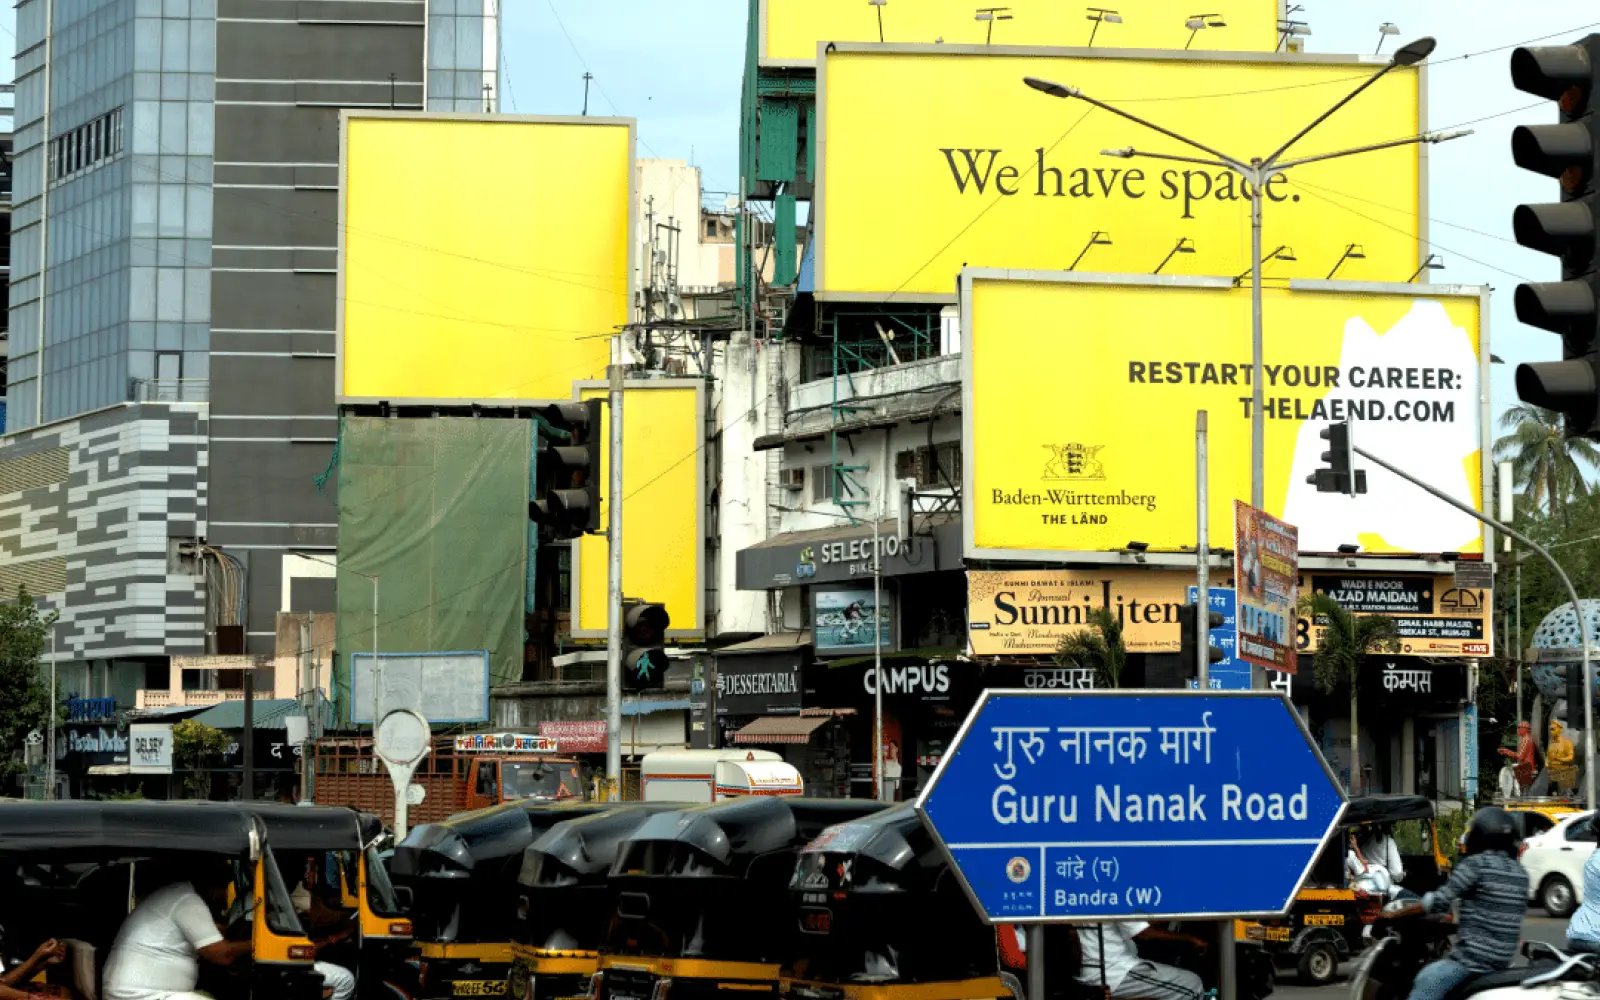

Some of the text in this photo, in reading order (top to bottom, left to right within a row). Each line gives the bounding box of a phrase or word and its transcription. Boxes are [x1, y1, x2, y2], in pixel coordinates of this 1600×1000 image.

[939, 147, 1301, 219] We have space.
[1128, 362, 1463, 390] RESTART YOUR CAREER:
[1239, 397, 1456, 423] THELAEND.COM
[991, 488, 1157, 512] Baden-Württemberg
[1041, 512, 1108, 525] THE LÄND
[850, 563, 882, 575] BIKE
[1328, 590, 1419, 603] AZAD MAIDAN
[1341, 580, 1367, 590] WADI
[1375, 581, 1404, 590] NOOR
[994, 591, 1092, 626] Sunni
[726, 672, 799, 695] DESSERTARIA
[863, 664, 950, 694] CAMPUS
[1383, 662, 1433, 693] कॅम्पस
[992, 711, 1216, 779] गुरु नानक मार्ग
[991, 783, 1308, 823] Guru Nanak Road
[1055, 855, 1120, 882] वांद्रे (प)
[1054, 889, 1119, 907] Bandra
[1125, 886, 1162, 907] (W)
